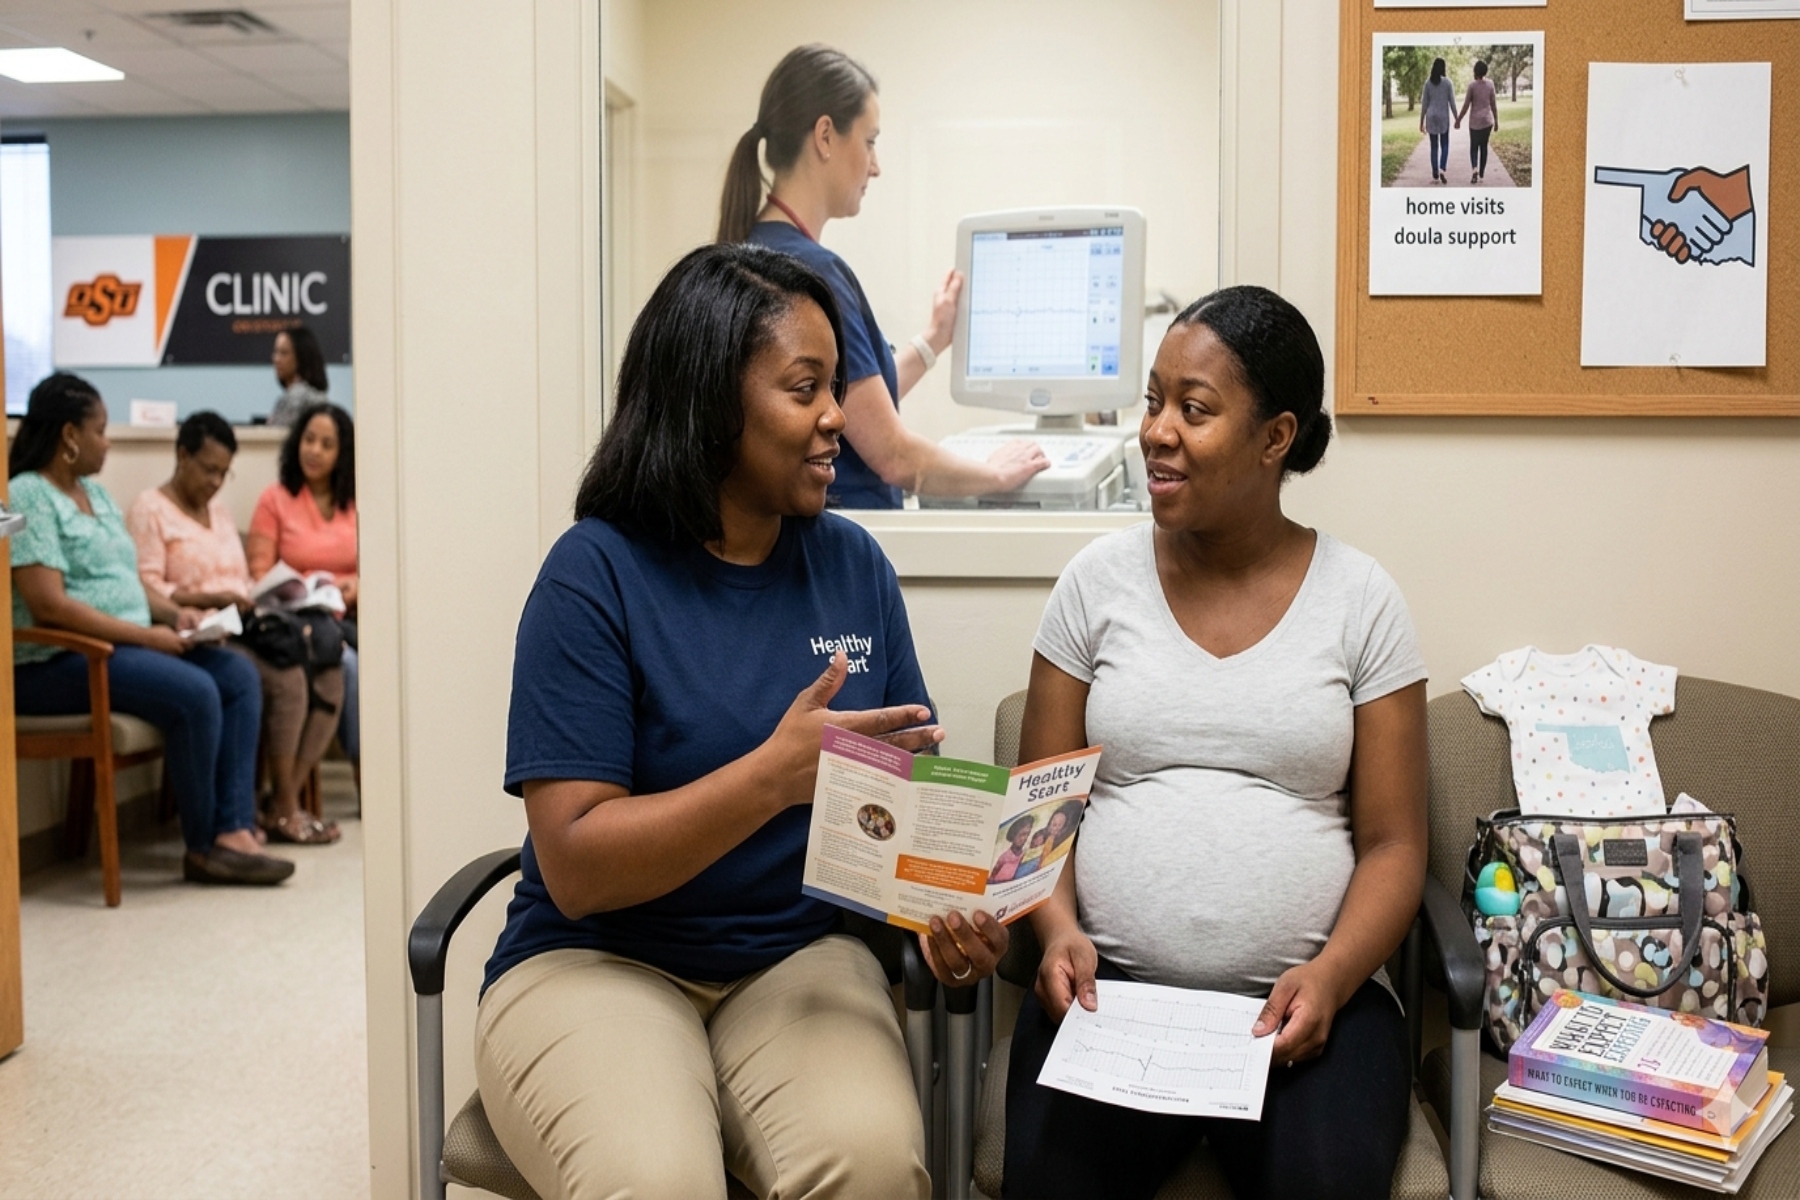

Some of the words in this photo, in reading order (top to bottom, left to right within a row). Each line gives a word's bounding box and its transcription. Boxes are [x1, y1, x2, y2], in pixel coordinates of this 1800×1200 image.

[1406, 196, 1456, 215] home
[1460, 196, 1505, 215] visits
[1394, 226, 1443, 245] doula
[1448, 228, 1517, 250] support
[205, 271, 328, 316] CLINIC
[810, 633, 872, 656] Healthy
[1551, 1072, 1562, 1085] TO
